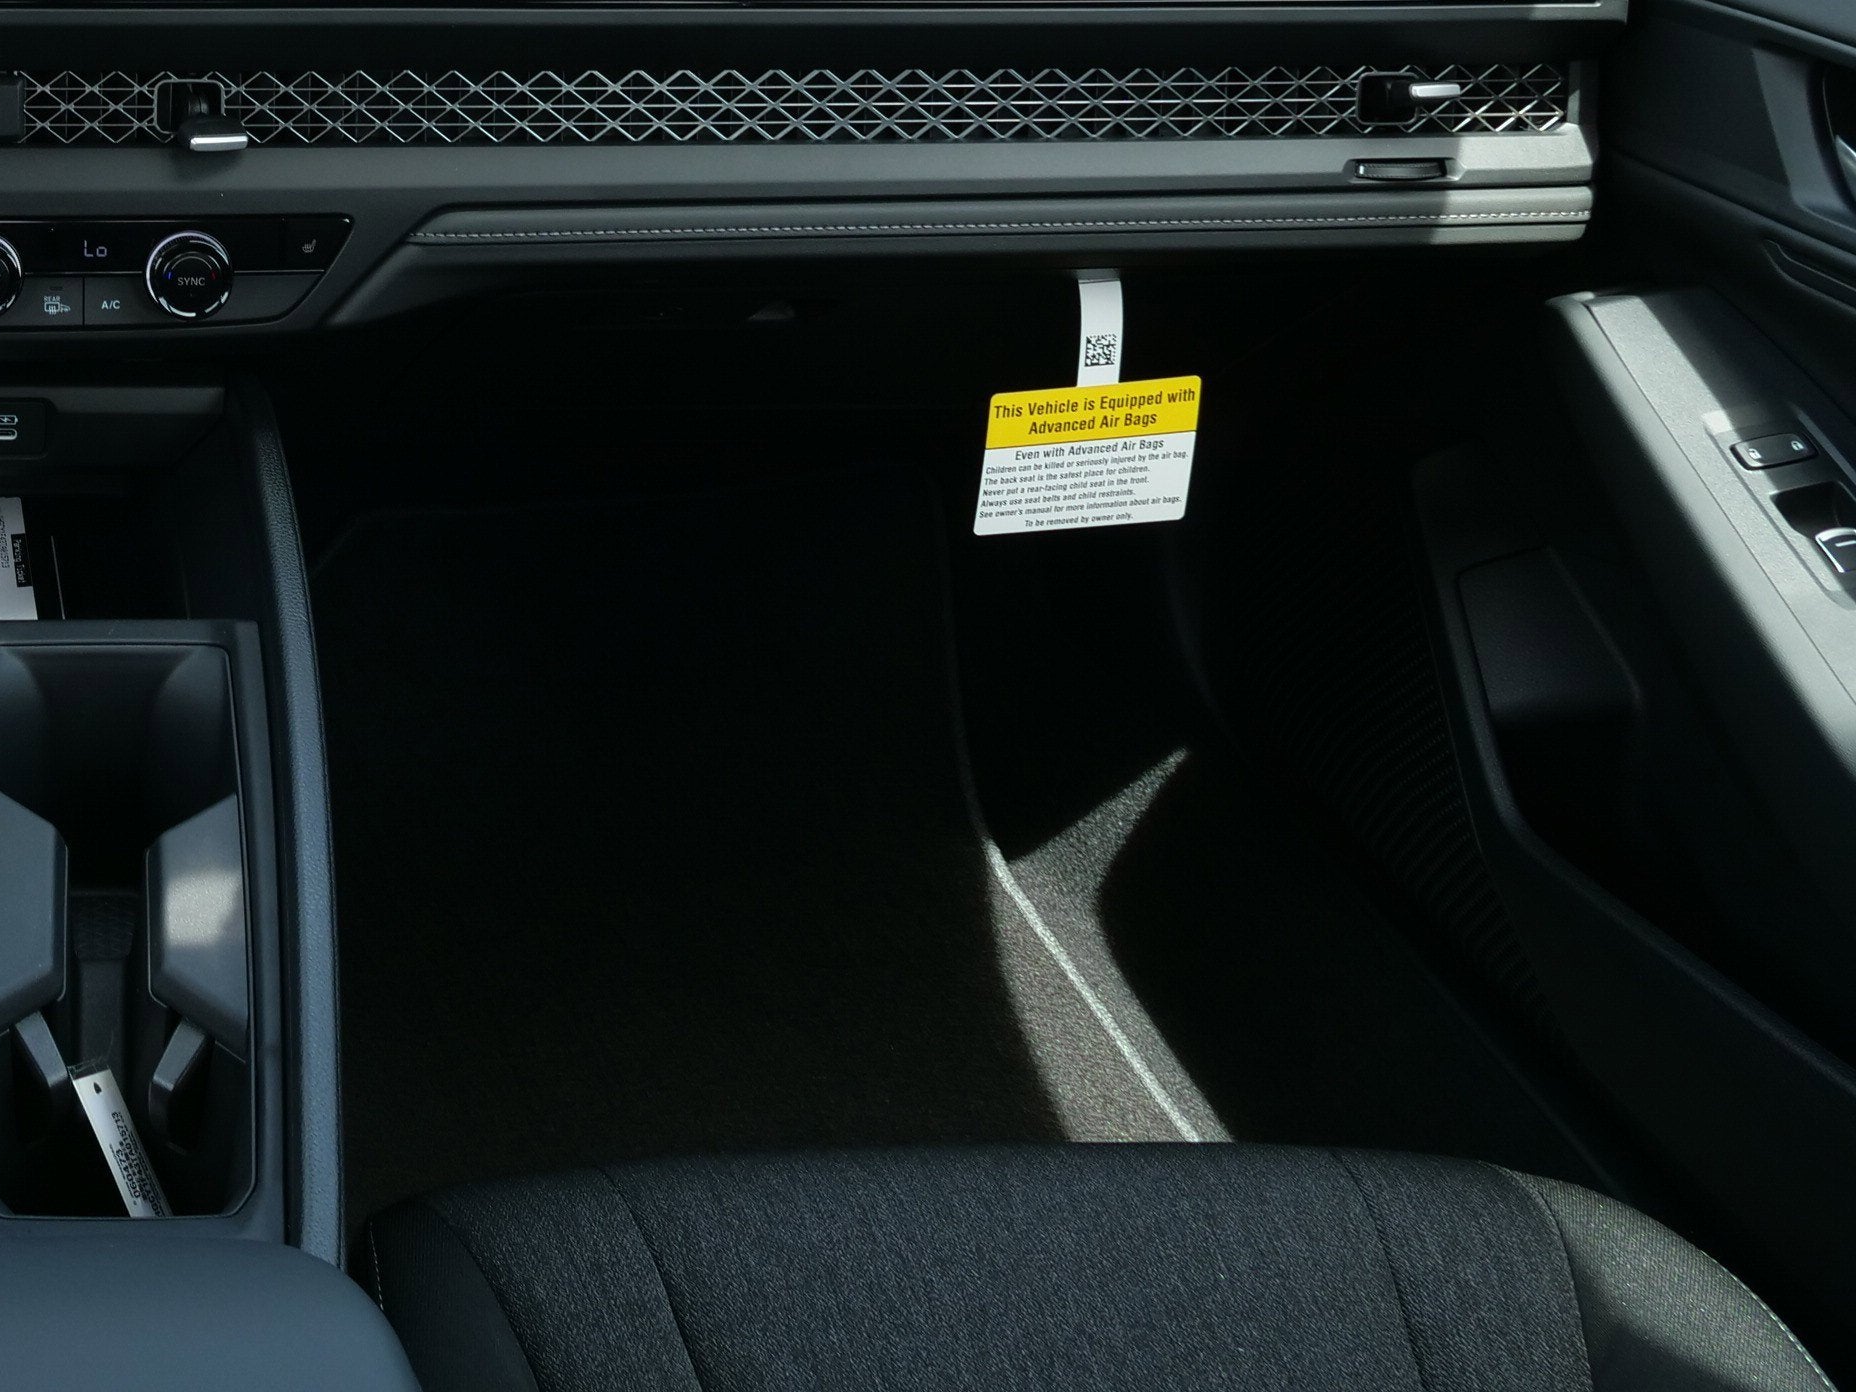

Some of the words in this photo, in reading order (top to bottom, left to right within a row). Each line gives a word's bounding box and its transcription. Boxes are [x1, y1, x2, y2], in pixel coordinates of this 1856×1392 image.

[176, 276, 206, 286] SYNC
[101, 299, 121, 310] A/C
[994, 404, 1023, 419] This
[1028, 399, 1078, 416] Vehicle
[1084, 398, 1094, 411] is
[1100, 391, 1162, 410] Equipped
[1167, 388, 1195, 402] with
[1028, 417, 1095, 435] Advanced
[1100, 414, 1119, 429] Air
[1124, 411, 1157, 427] Bags
[1015, 449, 1040, 460] Even
[1043, 447, 1065, 458] with
[1068, 442, 1118, 456] Advanced
[1121, 441, 1136, 452] Air
[1139, 438, 1164, 451] Bags
[986, 465, 1017, 475] Children
[1018, 464, 1032, 472] can
[1034, 463, 1043, 471] be
[1045, 460, 1065, 470] killed
[1076, 457, 1109, 469] seriously
[1111, 455, 1135, 465] injured
[1137, 454, 1146, 464] by
[1148, 453, 1159, 461] the
[1161, 452, 1171, 460] air
[1173, 451, 1188, 461] bag.
[983, 488, 1004, 496] Never
[1005, 486, 1018, 496] put
[1027, 481, 1068, 493] rear-facing
[1070, 480, 1087, 489] child
[1090, 479, 1106, 488] seat
[1116, 477, 1128, 486] the
[1130, 476, 1149, 484] front.
[985, 477, 998, 485] The
[1000, 475, 1017, 484] back
[1019, 474, 1035, 483] seat
[1038, 473, 1044, 481] is
[1045, 471, 1057, 480] the
[1059, 469, 1081, 479] safest
[1084, 468, 1104, 479] place
[1106, 467, 1116, 475] for
[1118, 465, 1150, 475] children.
[979, 510, 992, 518] See
[993, 508, 1023, 518] owner's
[1025, 506, 1052, 515] manual
[1054, 505, 1064, 513] for
[1066, 504, 1084, 512] more
[1086, 500, 1127, 510] information
[1129, 498, 1149, 507] about
[1151, 497, 1161, 505] air
[1162, 495, 1182, 505] bags.
[981, 498, 1007, 508] Always
[1024, 495, 1040, 504] seat
[1042, 494, 1061, 503] belts
[1063, 493, 1076, 501] and
[1078, 490, 1096, 500] child
[1098, 489, 1136, 498] restraints.
[1035, 518, 1044, 526] be
[1046, 515, 1079, 525] removed
[1081, 515, 1090, 524] by
[1092, 513, 1114, 521] owner
[1116, 512, 1133, 522] only.
[111, 1111, 164, 1218] HGCY1F43TA015713
[116, 1148, 141, 1198] 060473
